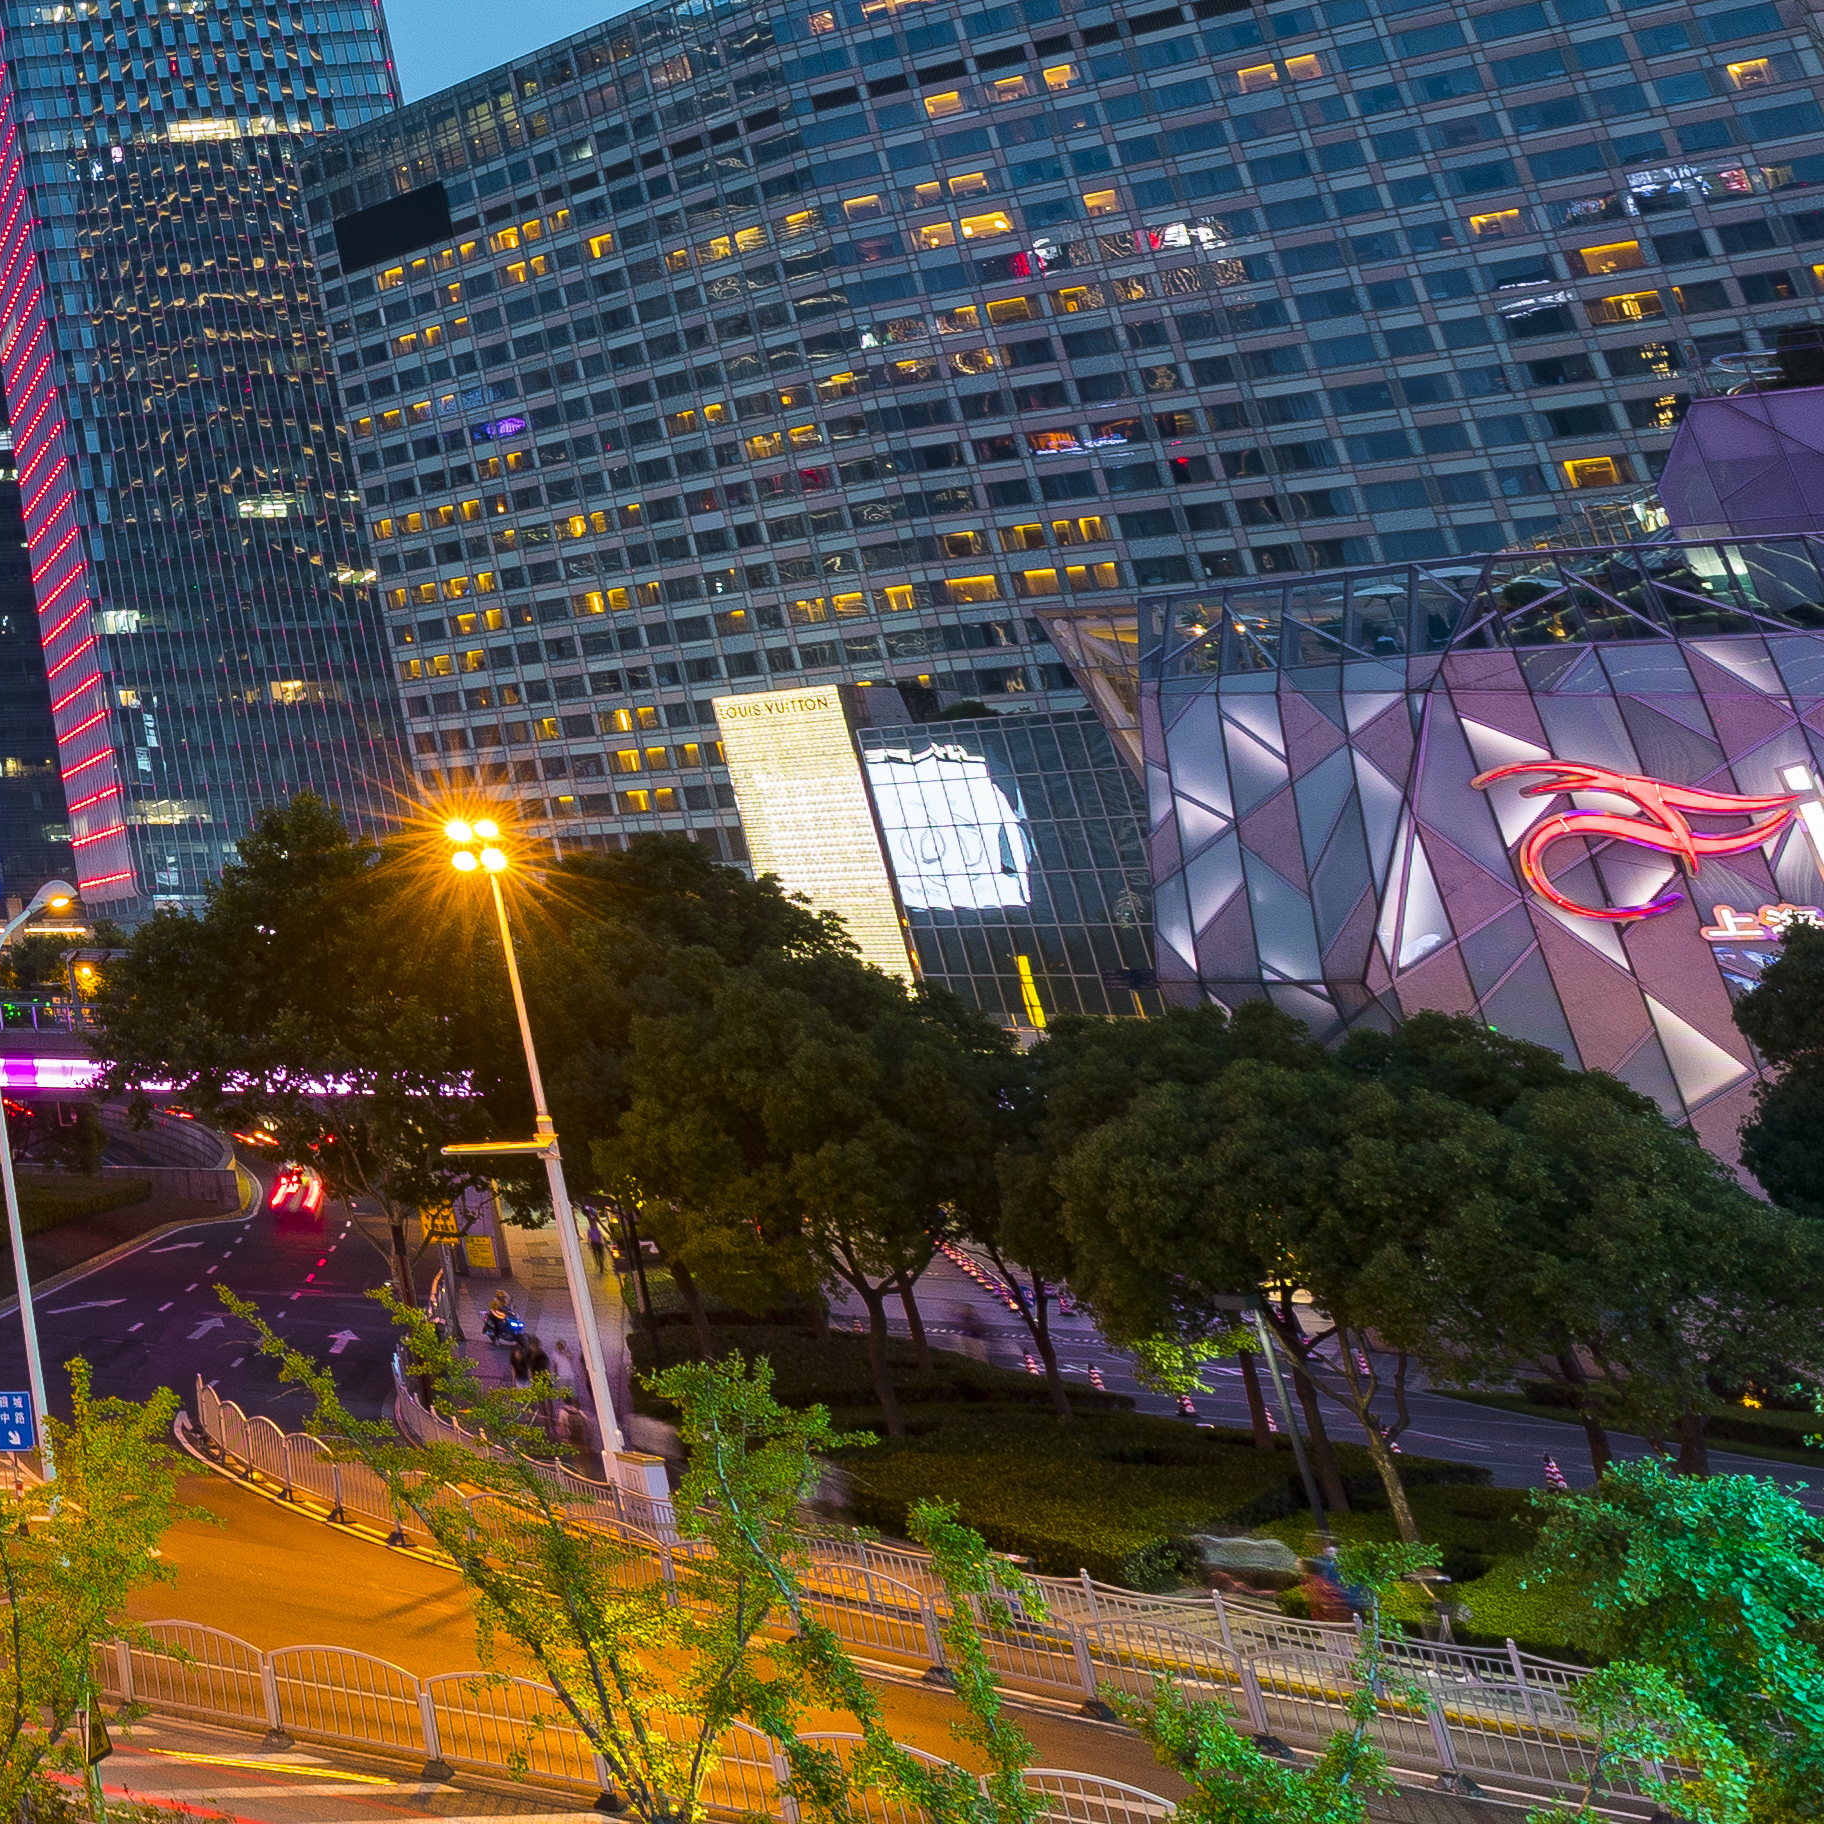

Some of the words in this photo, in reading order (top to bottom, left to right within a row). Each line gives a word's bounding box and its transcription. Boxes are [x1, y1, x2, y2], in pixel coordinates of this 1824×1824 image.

[718, 704, 761, 719] LOUIS
[764, 697, 829, 714] VUITTON
[0, 1412, 25, 1424] 中路
